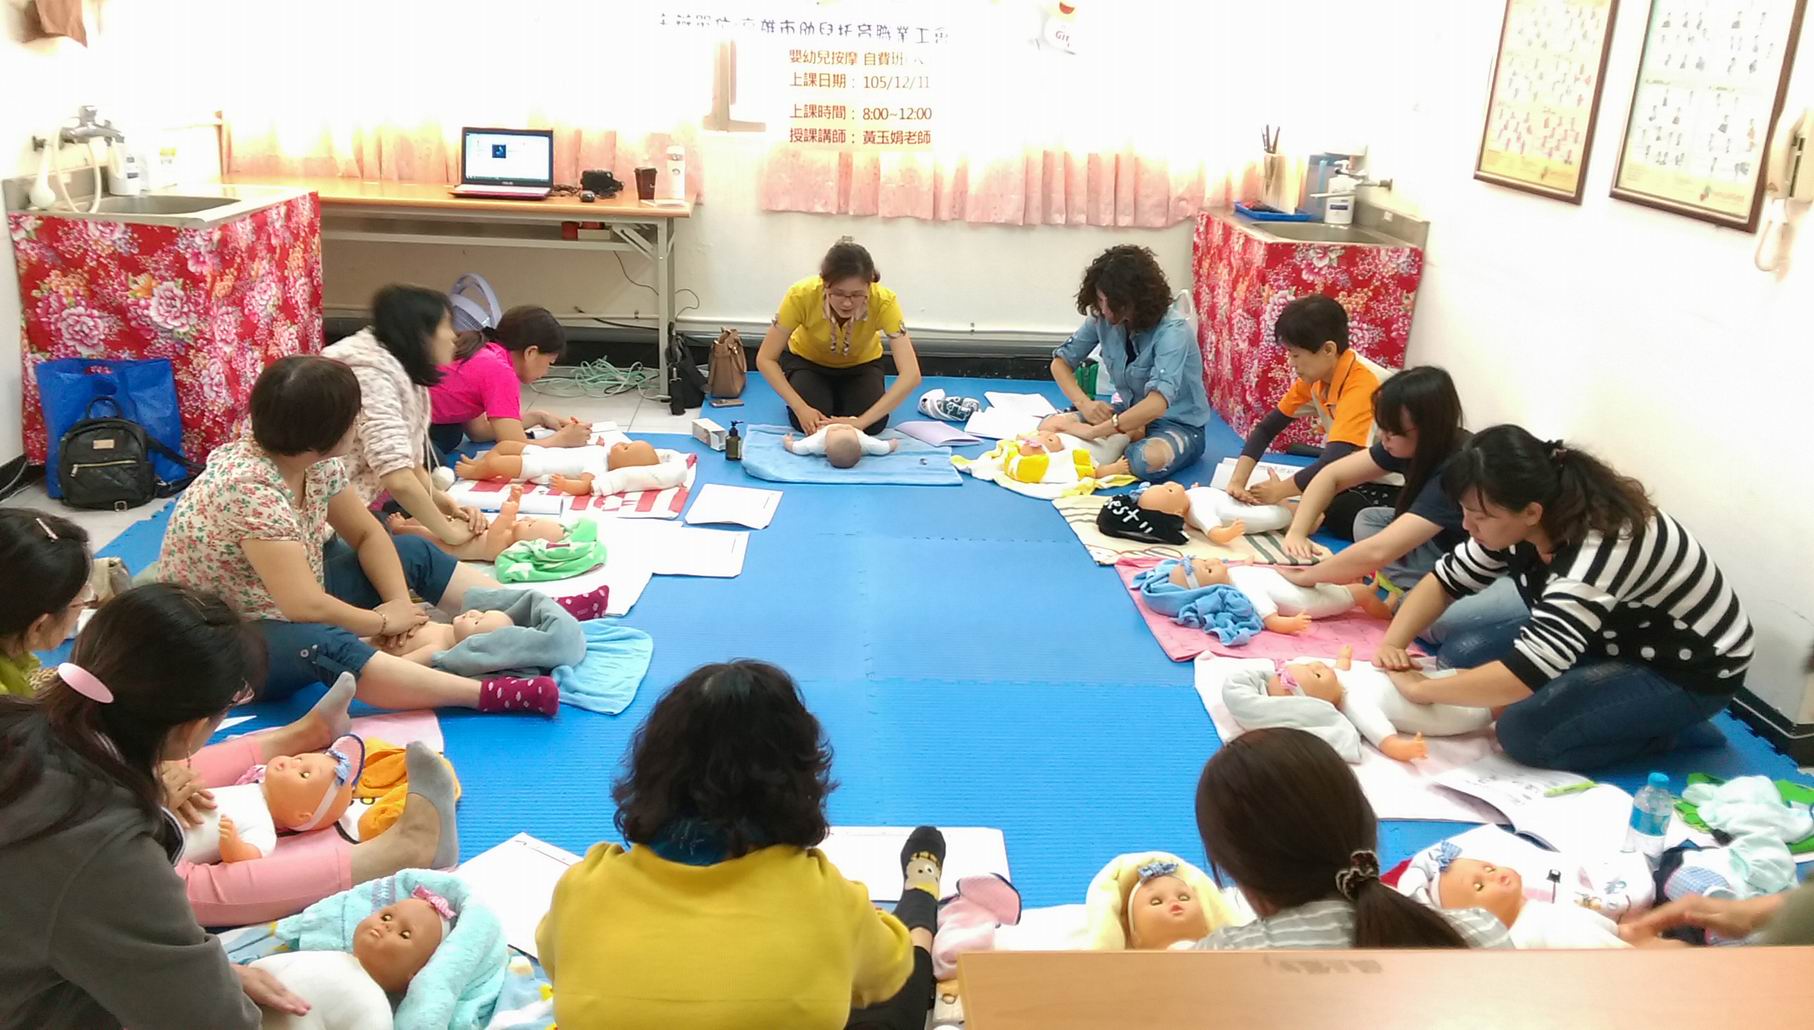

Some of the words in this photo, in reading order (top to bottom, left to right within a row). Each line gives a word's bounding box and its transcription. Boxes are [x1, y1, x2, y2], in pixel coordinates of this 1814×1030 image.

[789, 49, 858, 66] 嬰幼兒按摩
[864, 75, 930, 90] 105/12/11
[862, 107, 932, 120] 8:00~12:00
[862, 129, 932, 145] 黃玉娟老師
